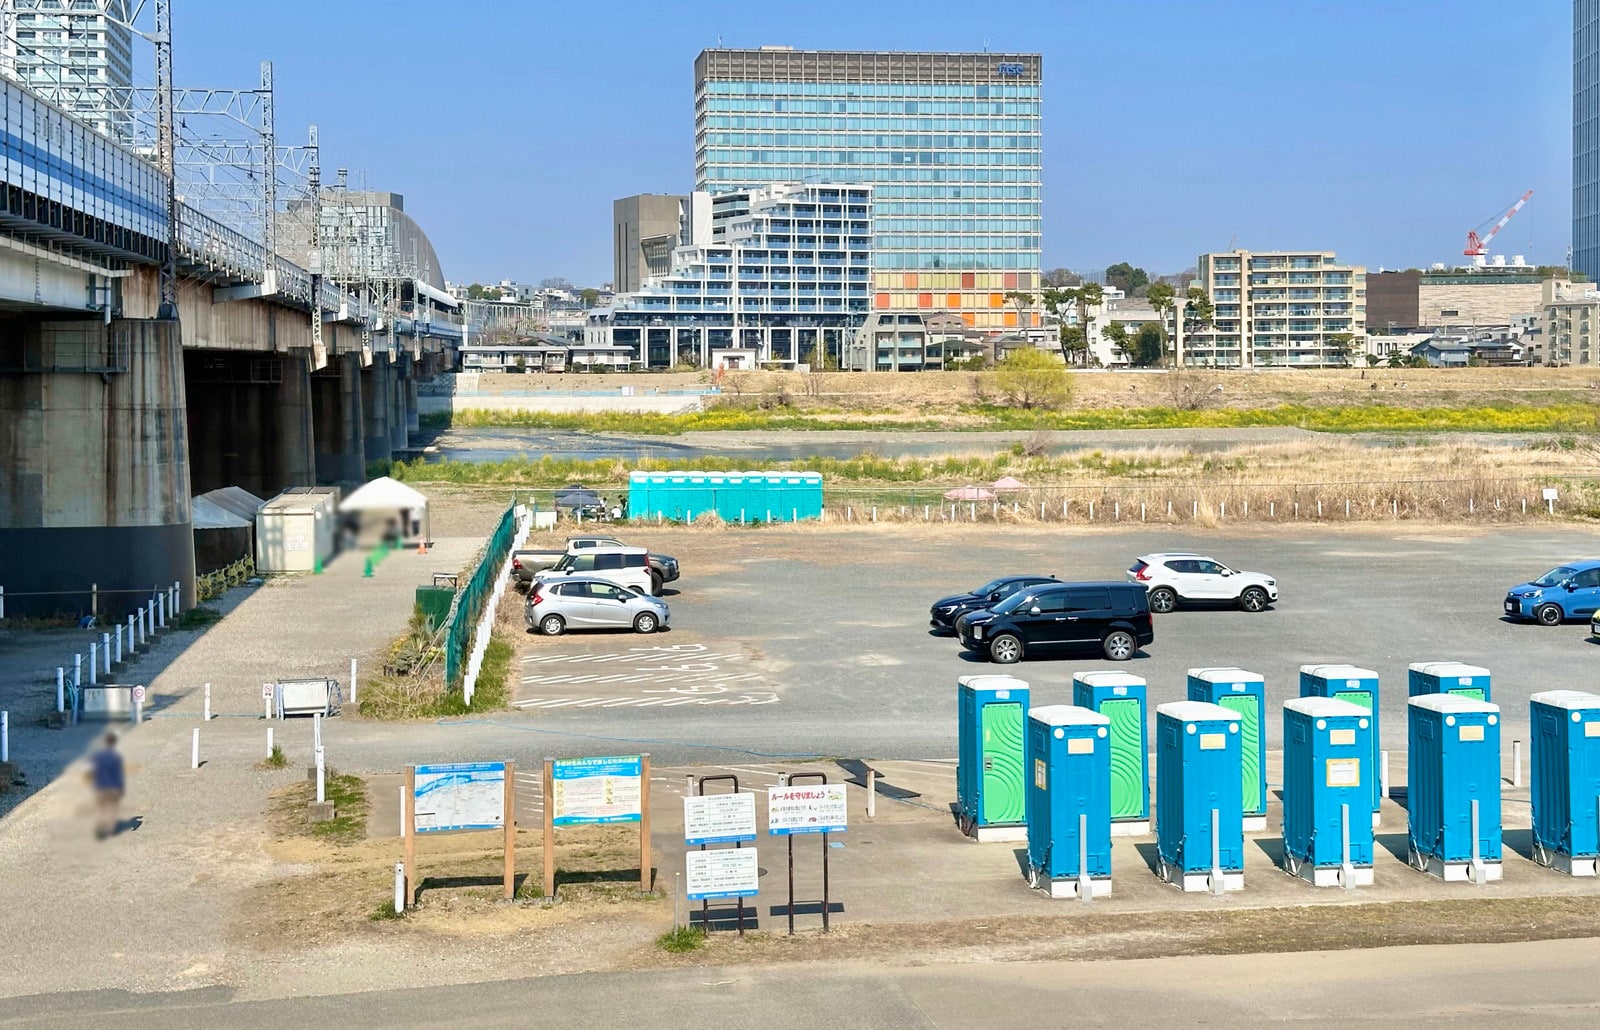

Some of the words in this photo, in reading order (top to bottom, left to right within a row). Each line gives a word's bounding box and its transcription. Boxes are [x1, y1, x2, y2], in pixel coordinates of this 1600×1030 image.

[771, 791, 825, 800] ルールを守りましょう
